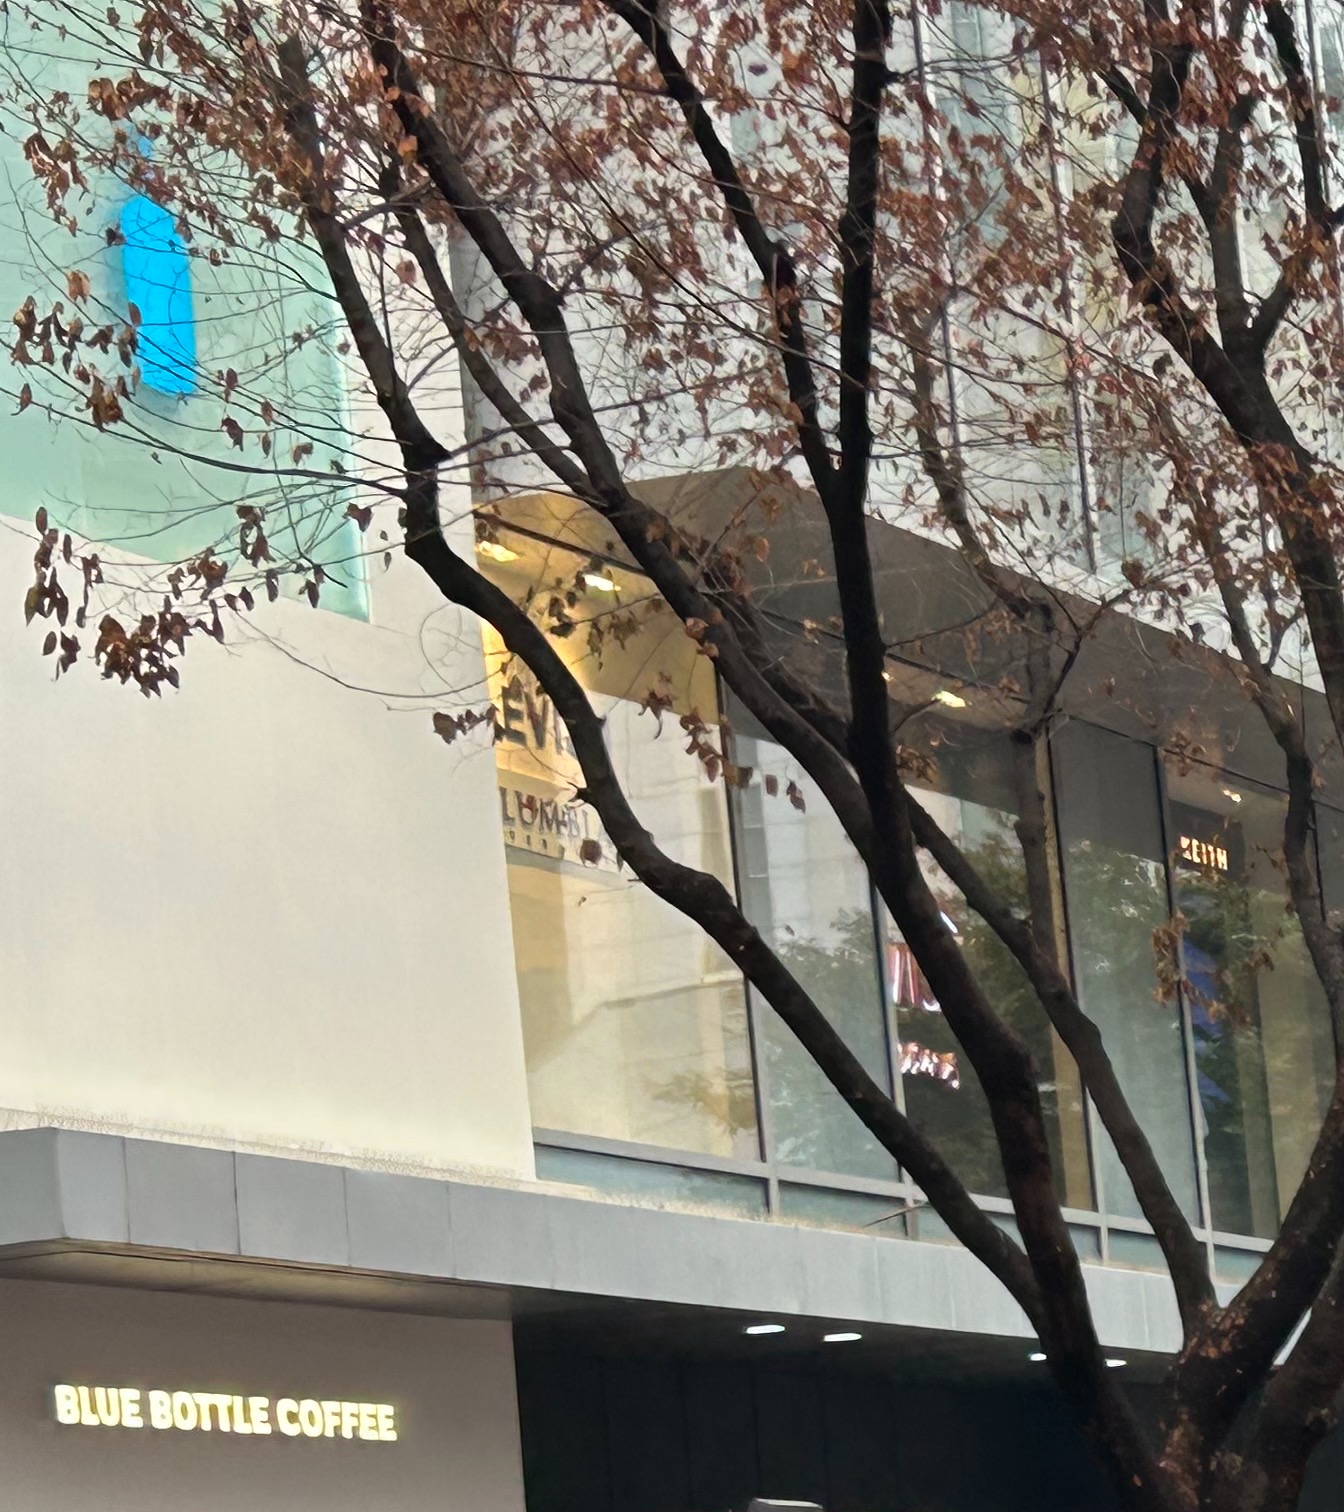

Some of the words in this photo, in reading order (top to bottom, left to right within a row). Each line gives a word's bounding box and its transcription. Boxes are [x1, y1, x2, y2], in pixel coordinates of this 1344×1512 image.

[54, 1384, 144, 1429] BLUE
[149, 1390, 272, 1435] BOTTLE
[276, 1398, 398, 1442] COFFEE
